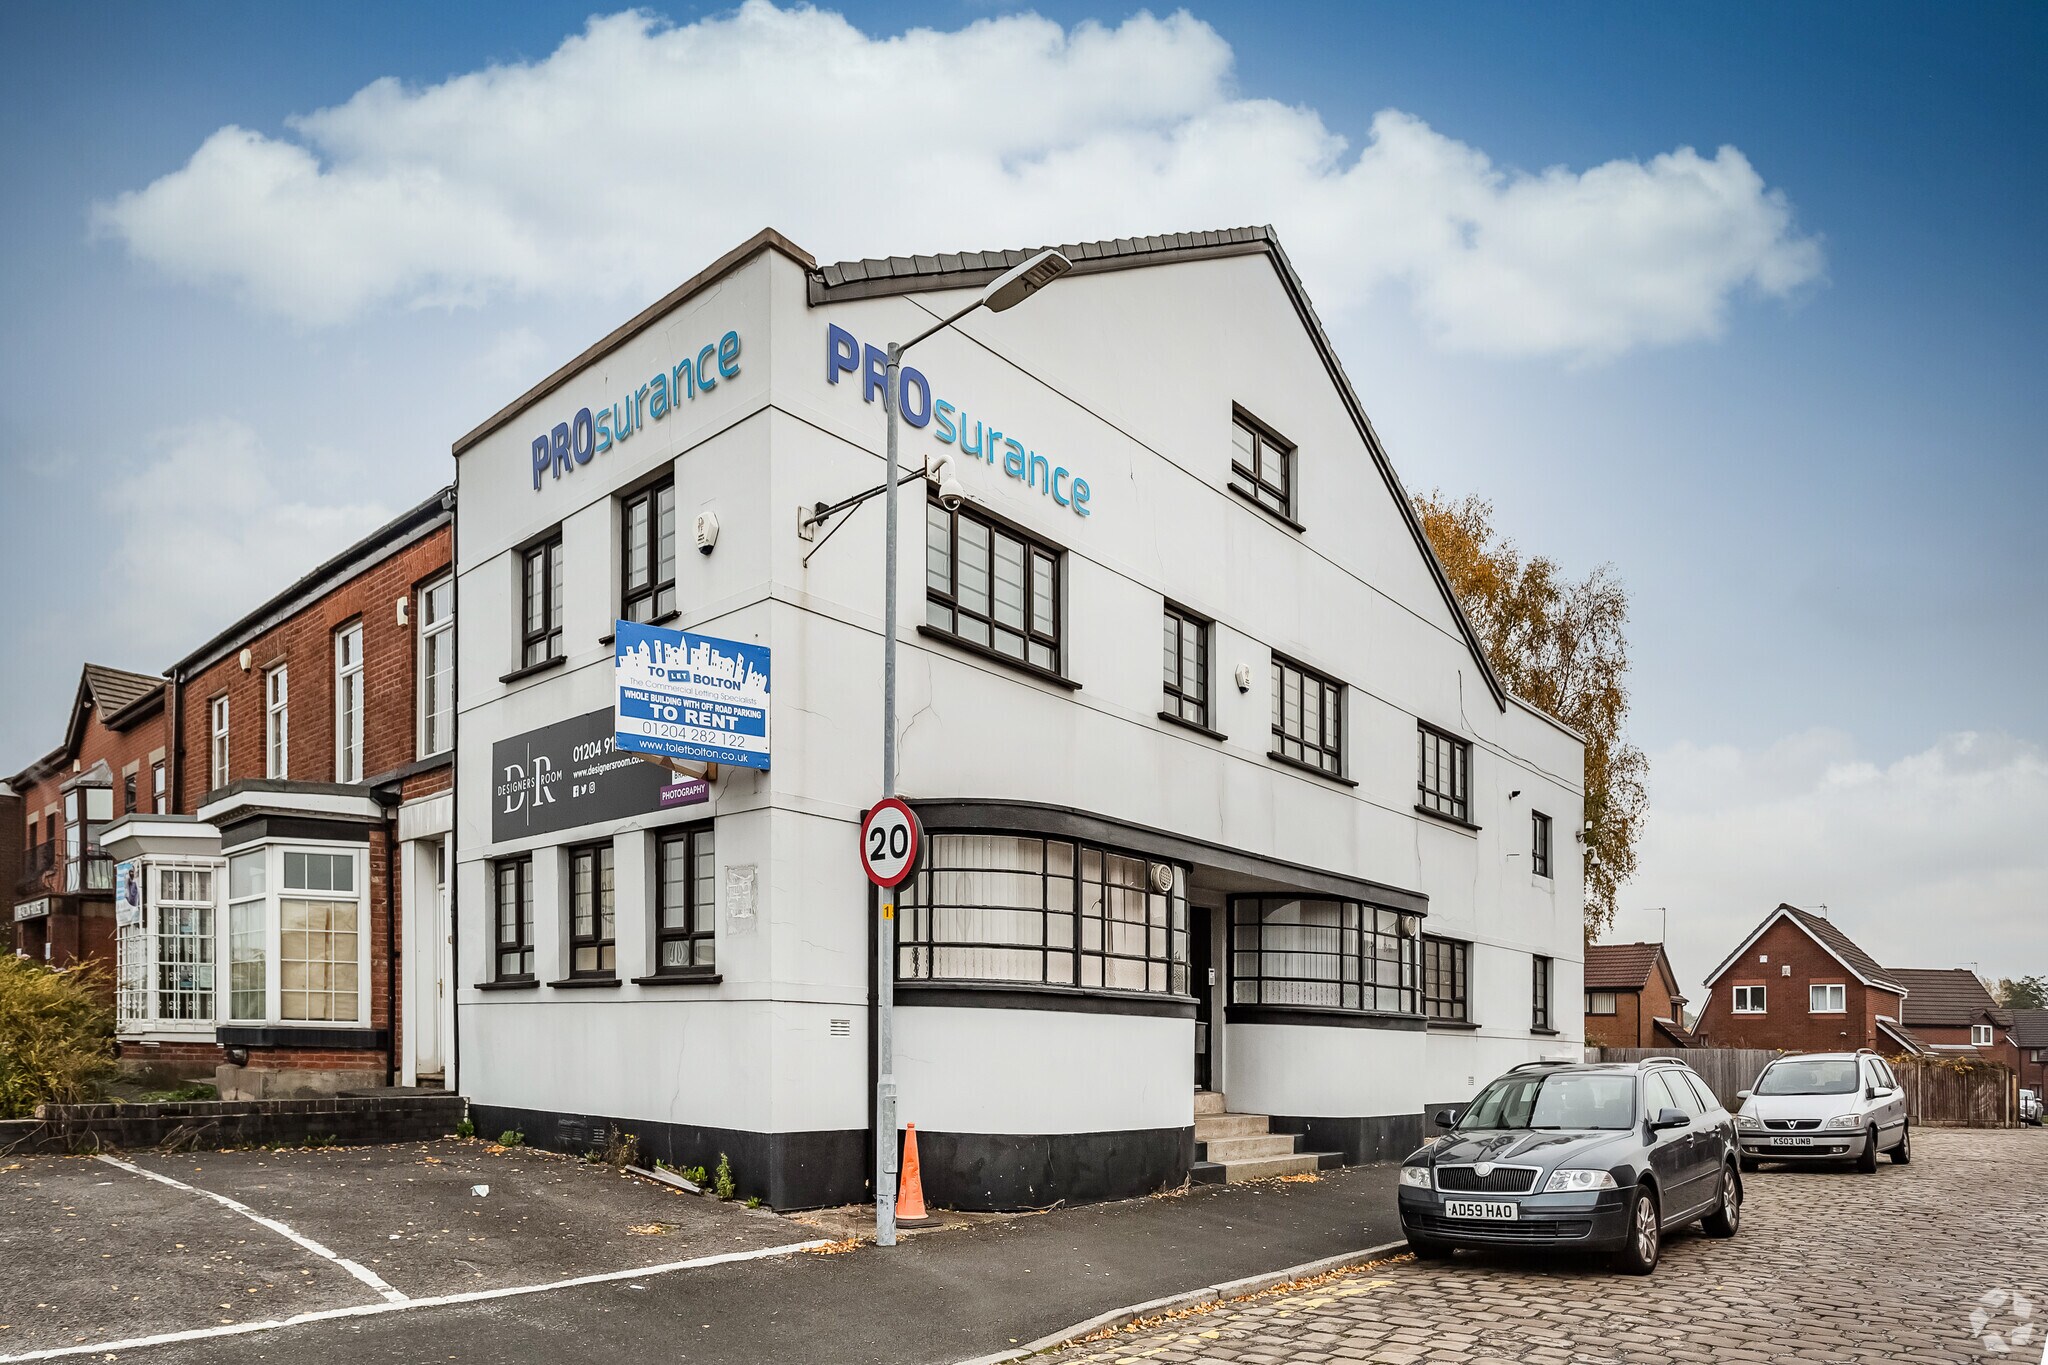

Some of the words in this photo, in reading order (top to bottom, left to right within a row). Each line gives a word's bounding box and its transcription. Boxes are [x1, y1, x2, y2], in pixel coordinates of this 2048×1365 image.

[532, 331, 742, 491] PROsurance
[826, 322, 1091, 516] PROsurance
[630, 677, 644, 686] The
[645, 680, 693, 695] Commercial
[694, 688, 719, 700] Letting
[720, 692, 757, 706] Specialists
[648, 666, 665, 678] TO
[670, 672, 688, 680] LET
[693, 673, 741, 691] BOLTON
[624, 689, 650, 701] WHOLE
[650, 693, 682, 706] BUILDING
[682, 698, 700, 709] WITH
[701, 702, 714, 712] OFF
[714, 704, 733, 715] ROAD
[733, 707, 762, 719] PARKING
[649, 703, 679, 721] TO
[685, 709, 739, 731] RENT
[642, 721, 687, 740] 01204
[691, 728, 716, 744] 282
[722, 732, 745, 748] 122
[573, 739, 602, 763] 01204
[604, 735, 616, 754] 91
[639, 740, 749, 763] www.toletbolton.co.uk
[497, 777, 535, 796] DESIGNERS
[540, 769, 562, 785] ROOM
[661, 783, 706, 801] PHOTOGRAPHY
[869, 824, 909, 861] 20
[1773, 1137, 1794, 1145] KS03
[1795, 1137, 1811, 1145] UNB
[1451, 1203, 1483, 1217] AD59
